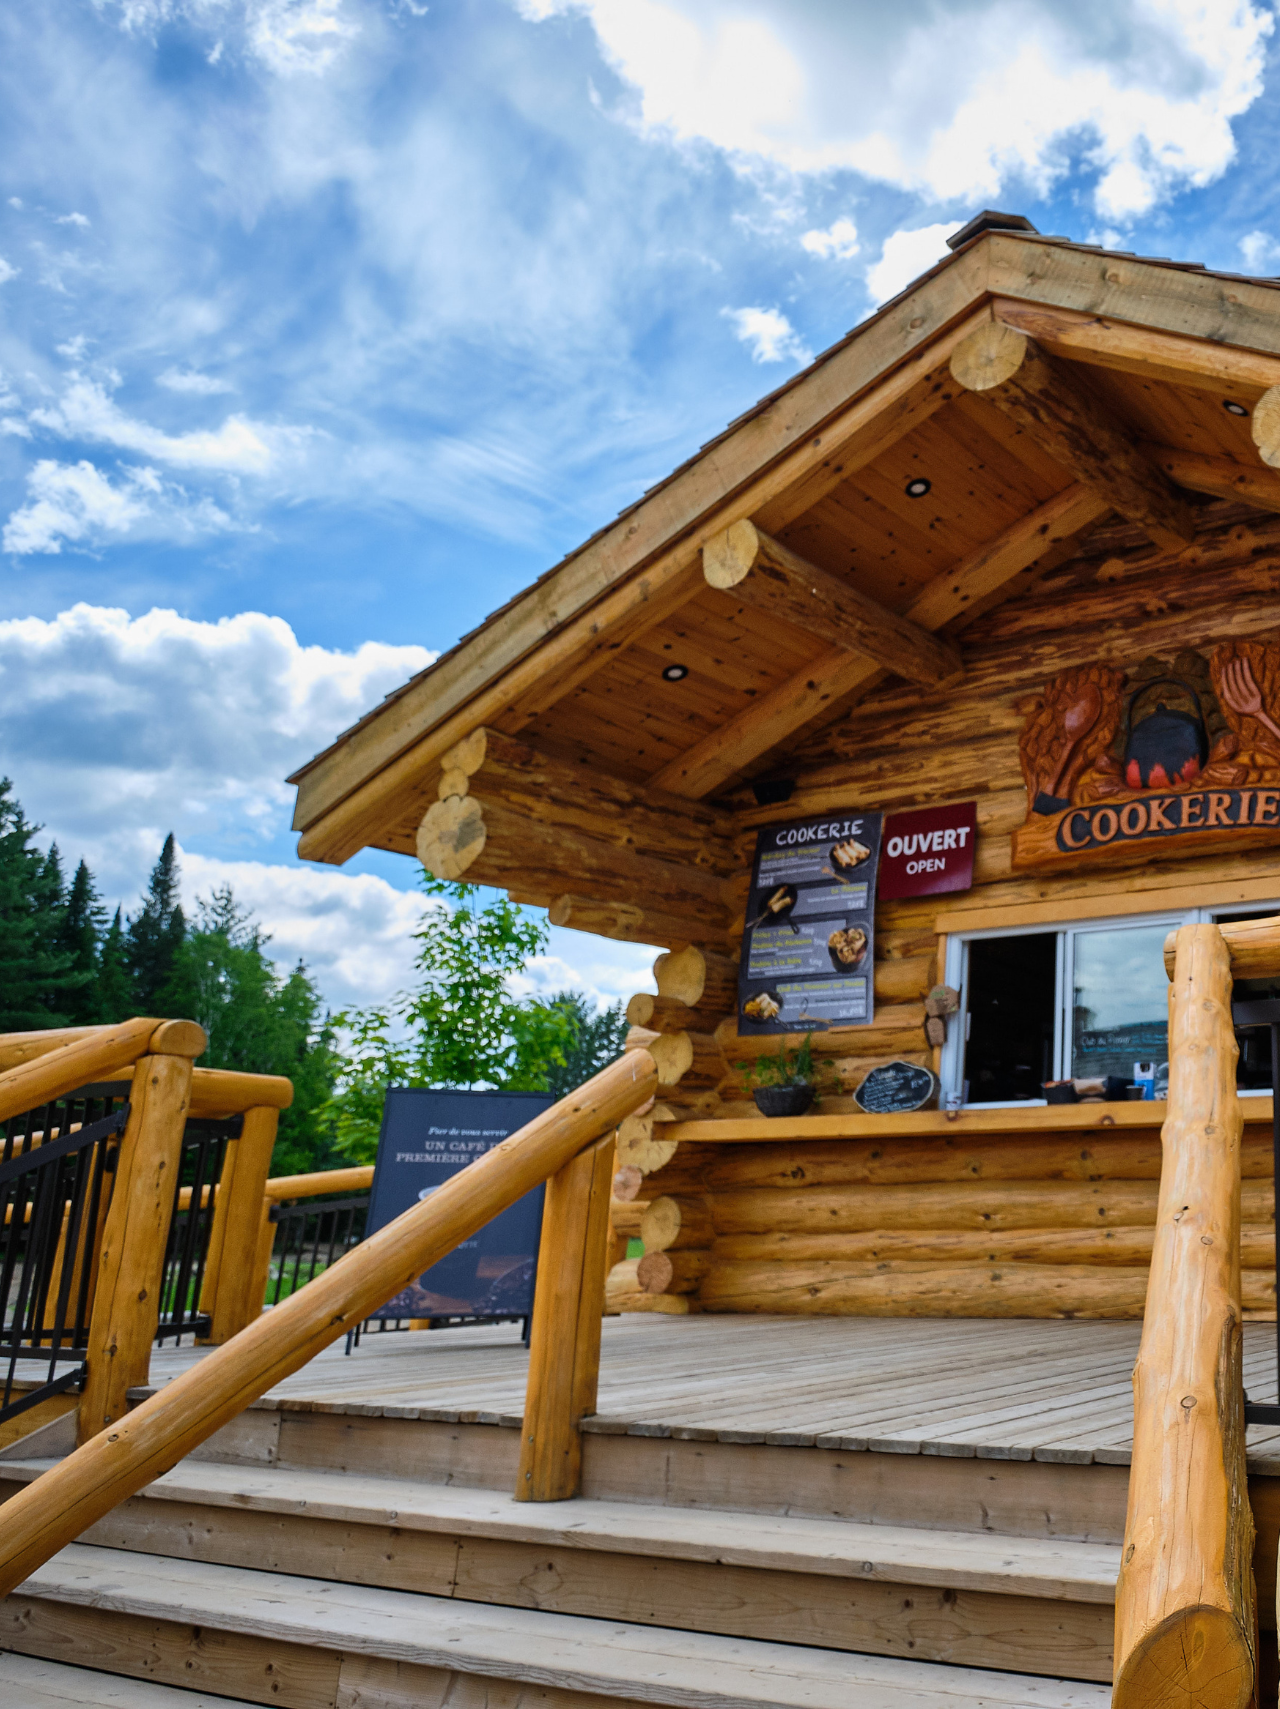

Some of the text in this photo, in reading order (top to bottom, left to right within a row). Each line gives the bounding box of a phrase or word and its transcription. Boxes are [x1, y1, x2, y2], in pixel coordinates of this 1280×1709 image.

[776, 819, 864, 846] COOKERIE
[886, 827, 971, 858] OUVERT
[906, 857, 946, 875] OPEN
[428, 1126, 448, 1136] Fier
[449, 1126, 460, 1136] de
[482, 1128, 508, 1137] servir
[425, 1141, 447, 1151] UN
[450, 1139, 486, 1152] CAFÉ
[396, 1152, 470, 1163] PREMIÈRE
